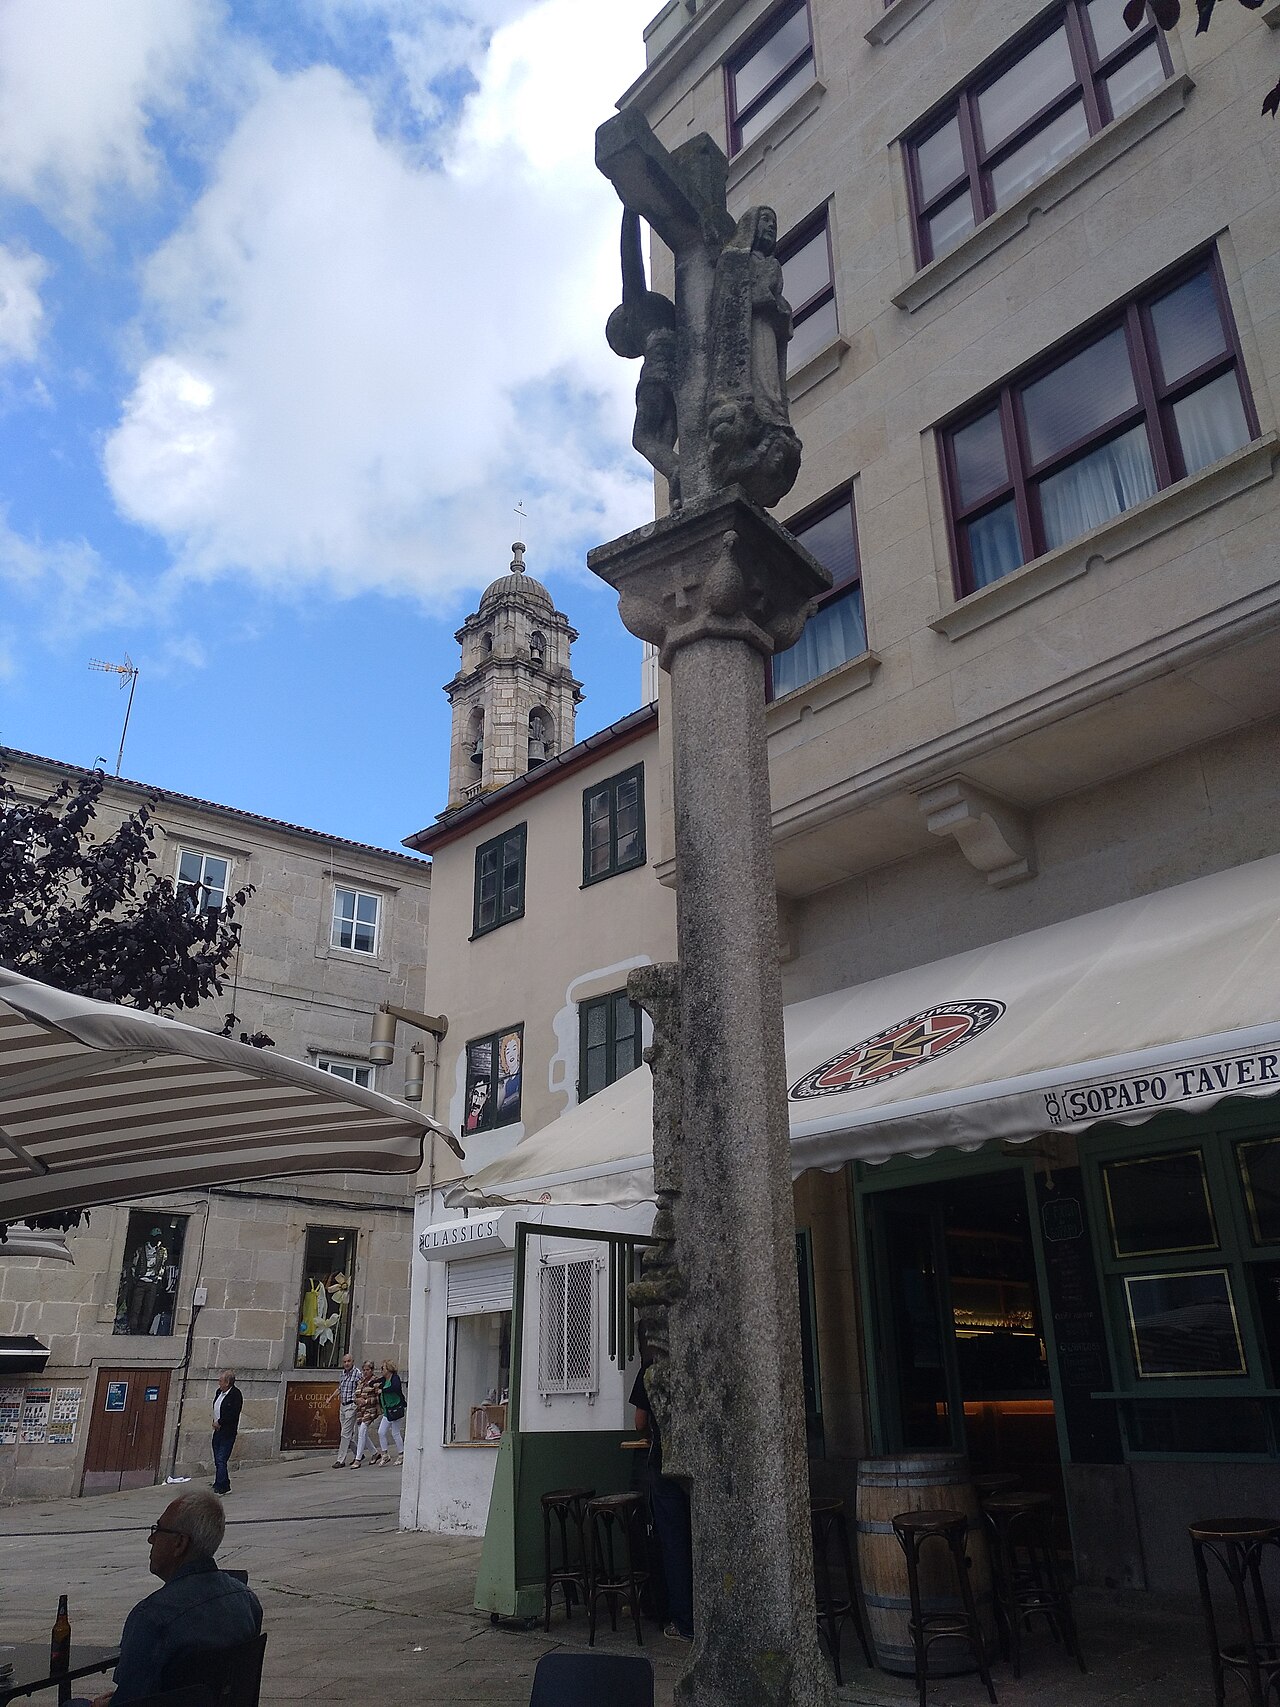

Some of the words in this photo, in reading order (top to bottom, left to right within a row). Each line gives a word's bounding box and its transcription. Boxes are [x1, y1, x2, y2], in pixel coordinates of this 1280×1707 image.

[1070, 1077, 1167, 1117] SOPAPO
[424, 1221, 493, 1248] CLASSICS
[293, 1393, 304, 1401] LA
[308, 1401, 332, 1409] STORE
